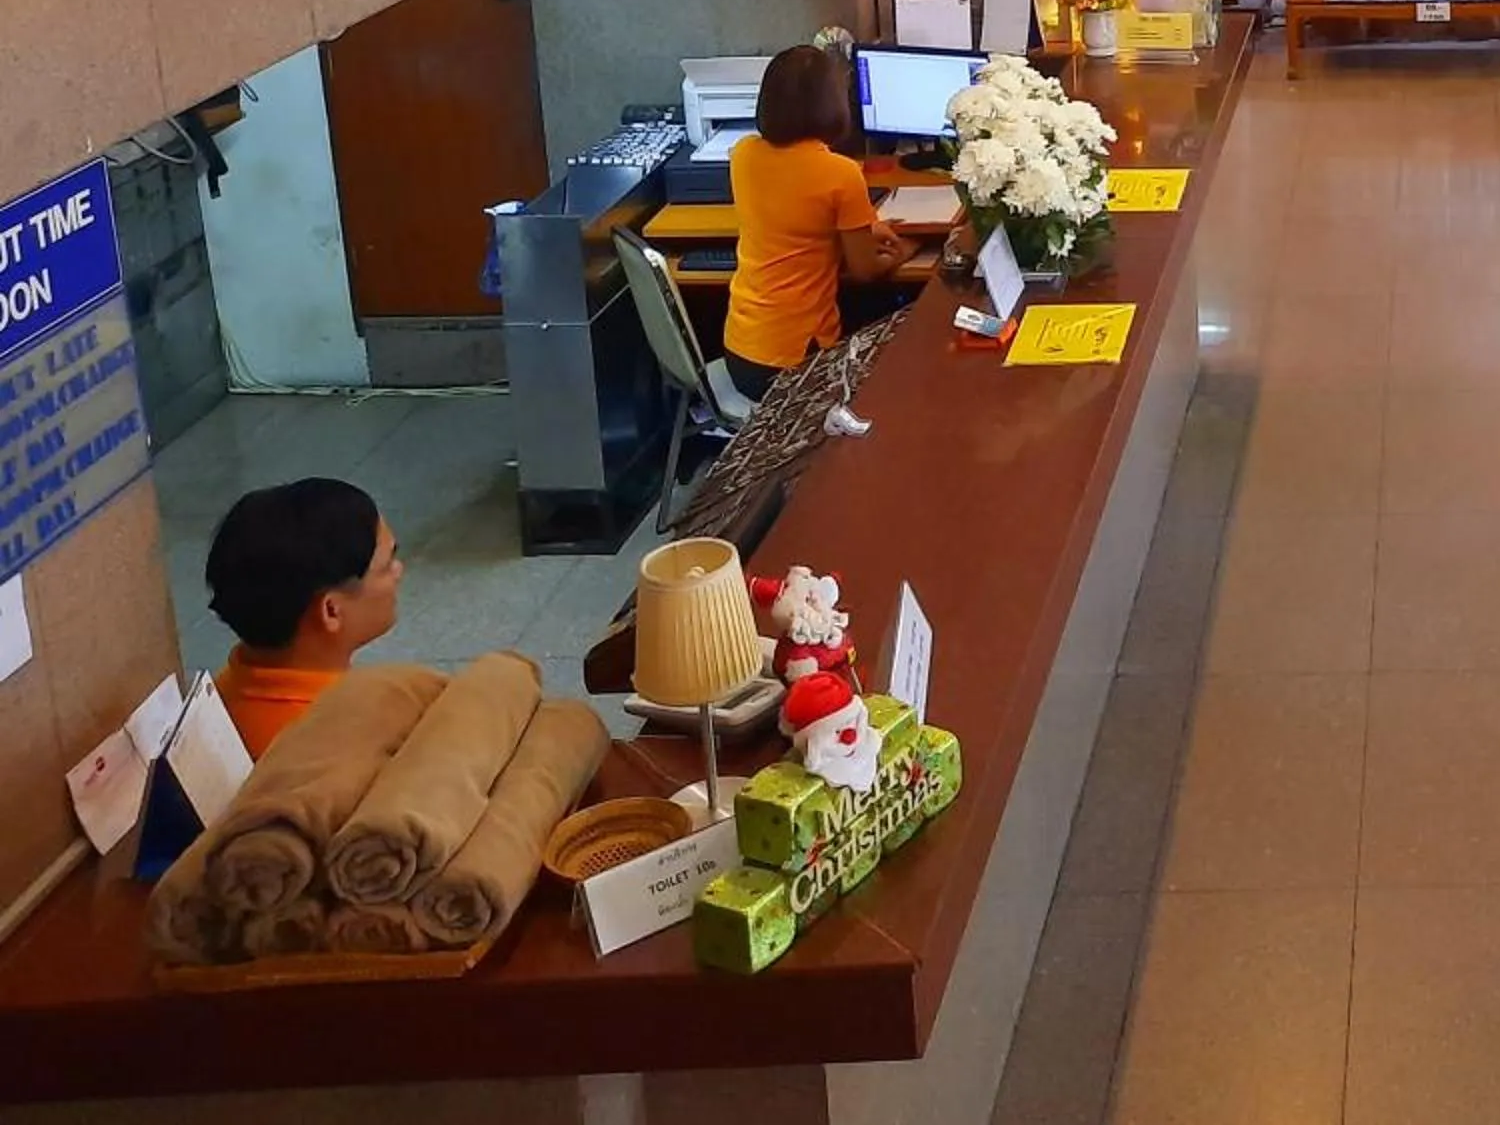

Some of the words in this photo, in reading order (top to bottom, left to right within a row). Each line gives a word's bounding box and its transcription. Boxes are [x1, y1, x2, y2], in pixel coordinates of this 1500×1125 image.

[29, 188, 95, 250] TIME
[823, 745, 922, 842] Merry
[648, 869, 690, 895] TOILET
[790, 771, 944, 914] Christmas
